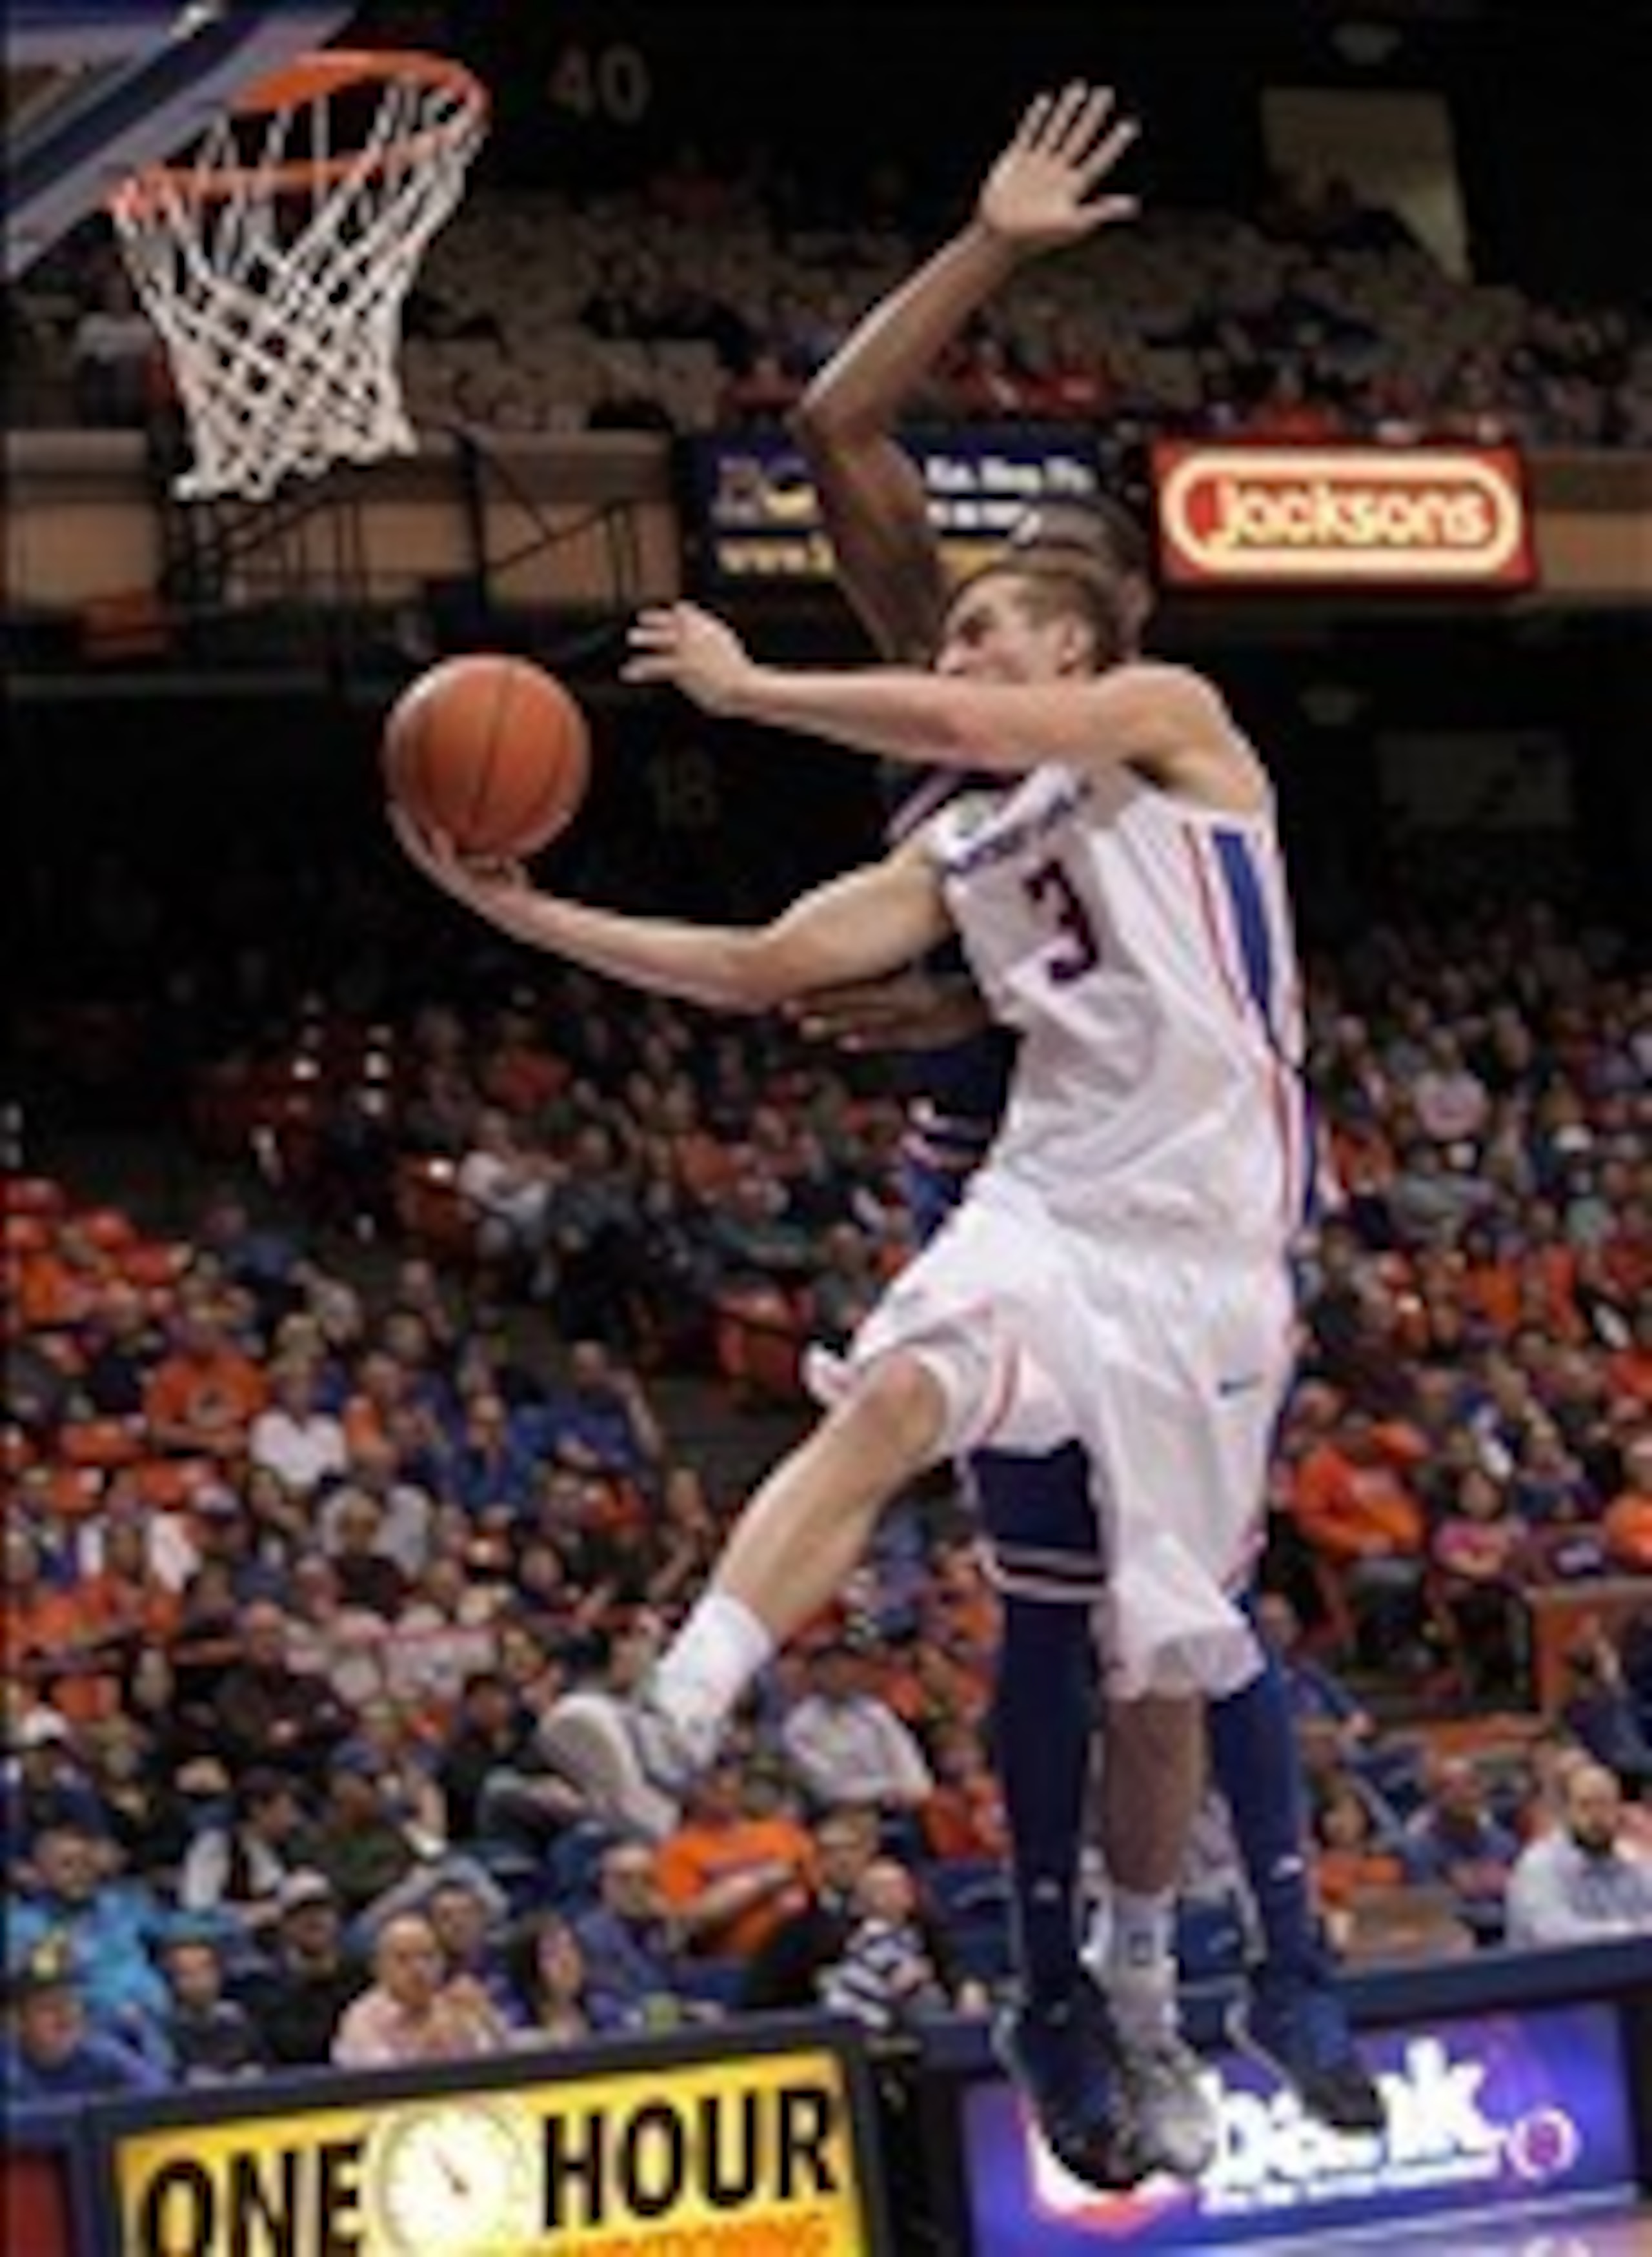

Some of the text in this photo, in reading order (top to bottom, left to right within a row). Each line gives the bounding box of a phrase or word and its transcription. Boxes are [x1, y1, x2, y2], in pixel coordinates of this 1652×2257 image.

[549, 44, 649, 123] 40
[1204, 474, 1489, 547] Jacksons
[1022, 858, 1098, 984] 3
[139, 2088, 839, 2257] ONE HOUR
